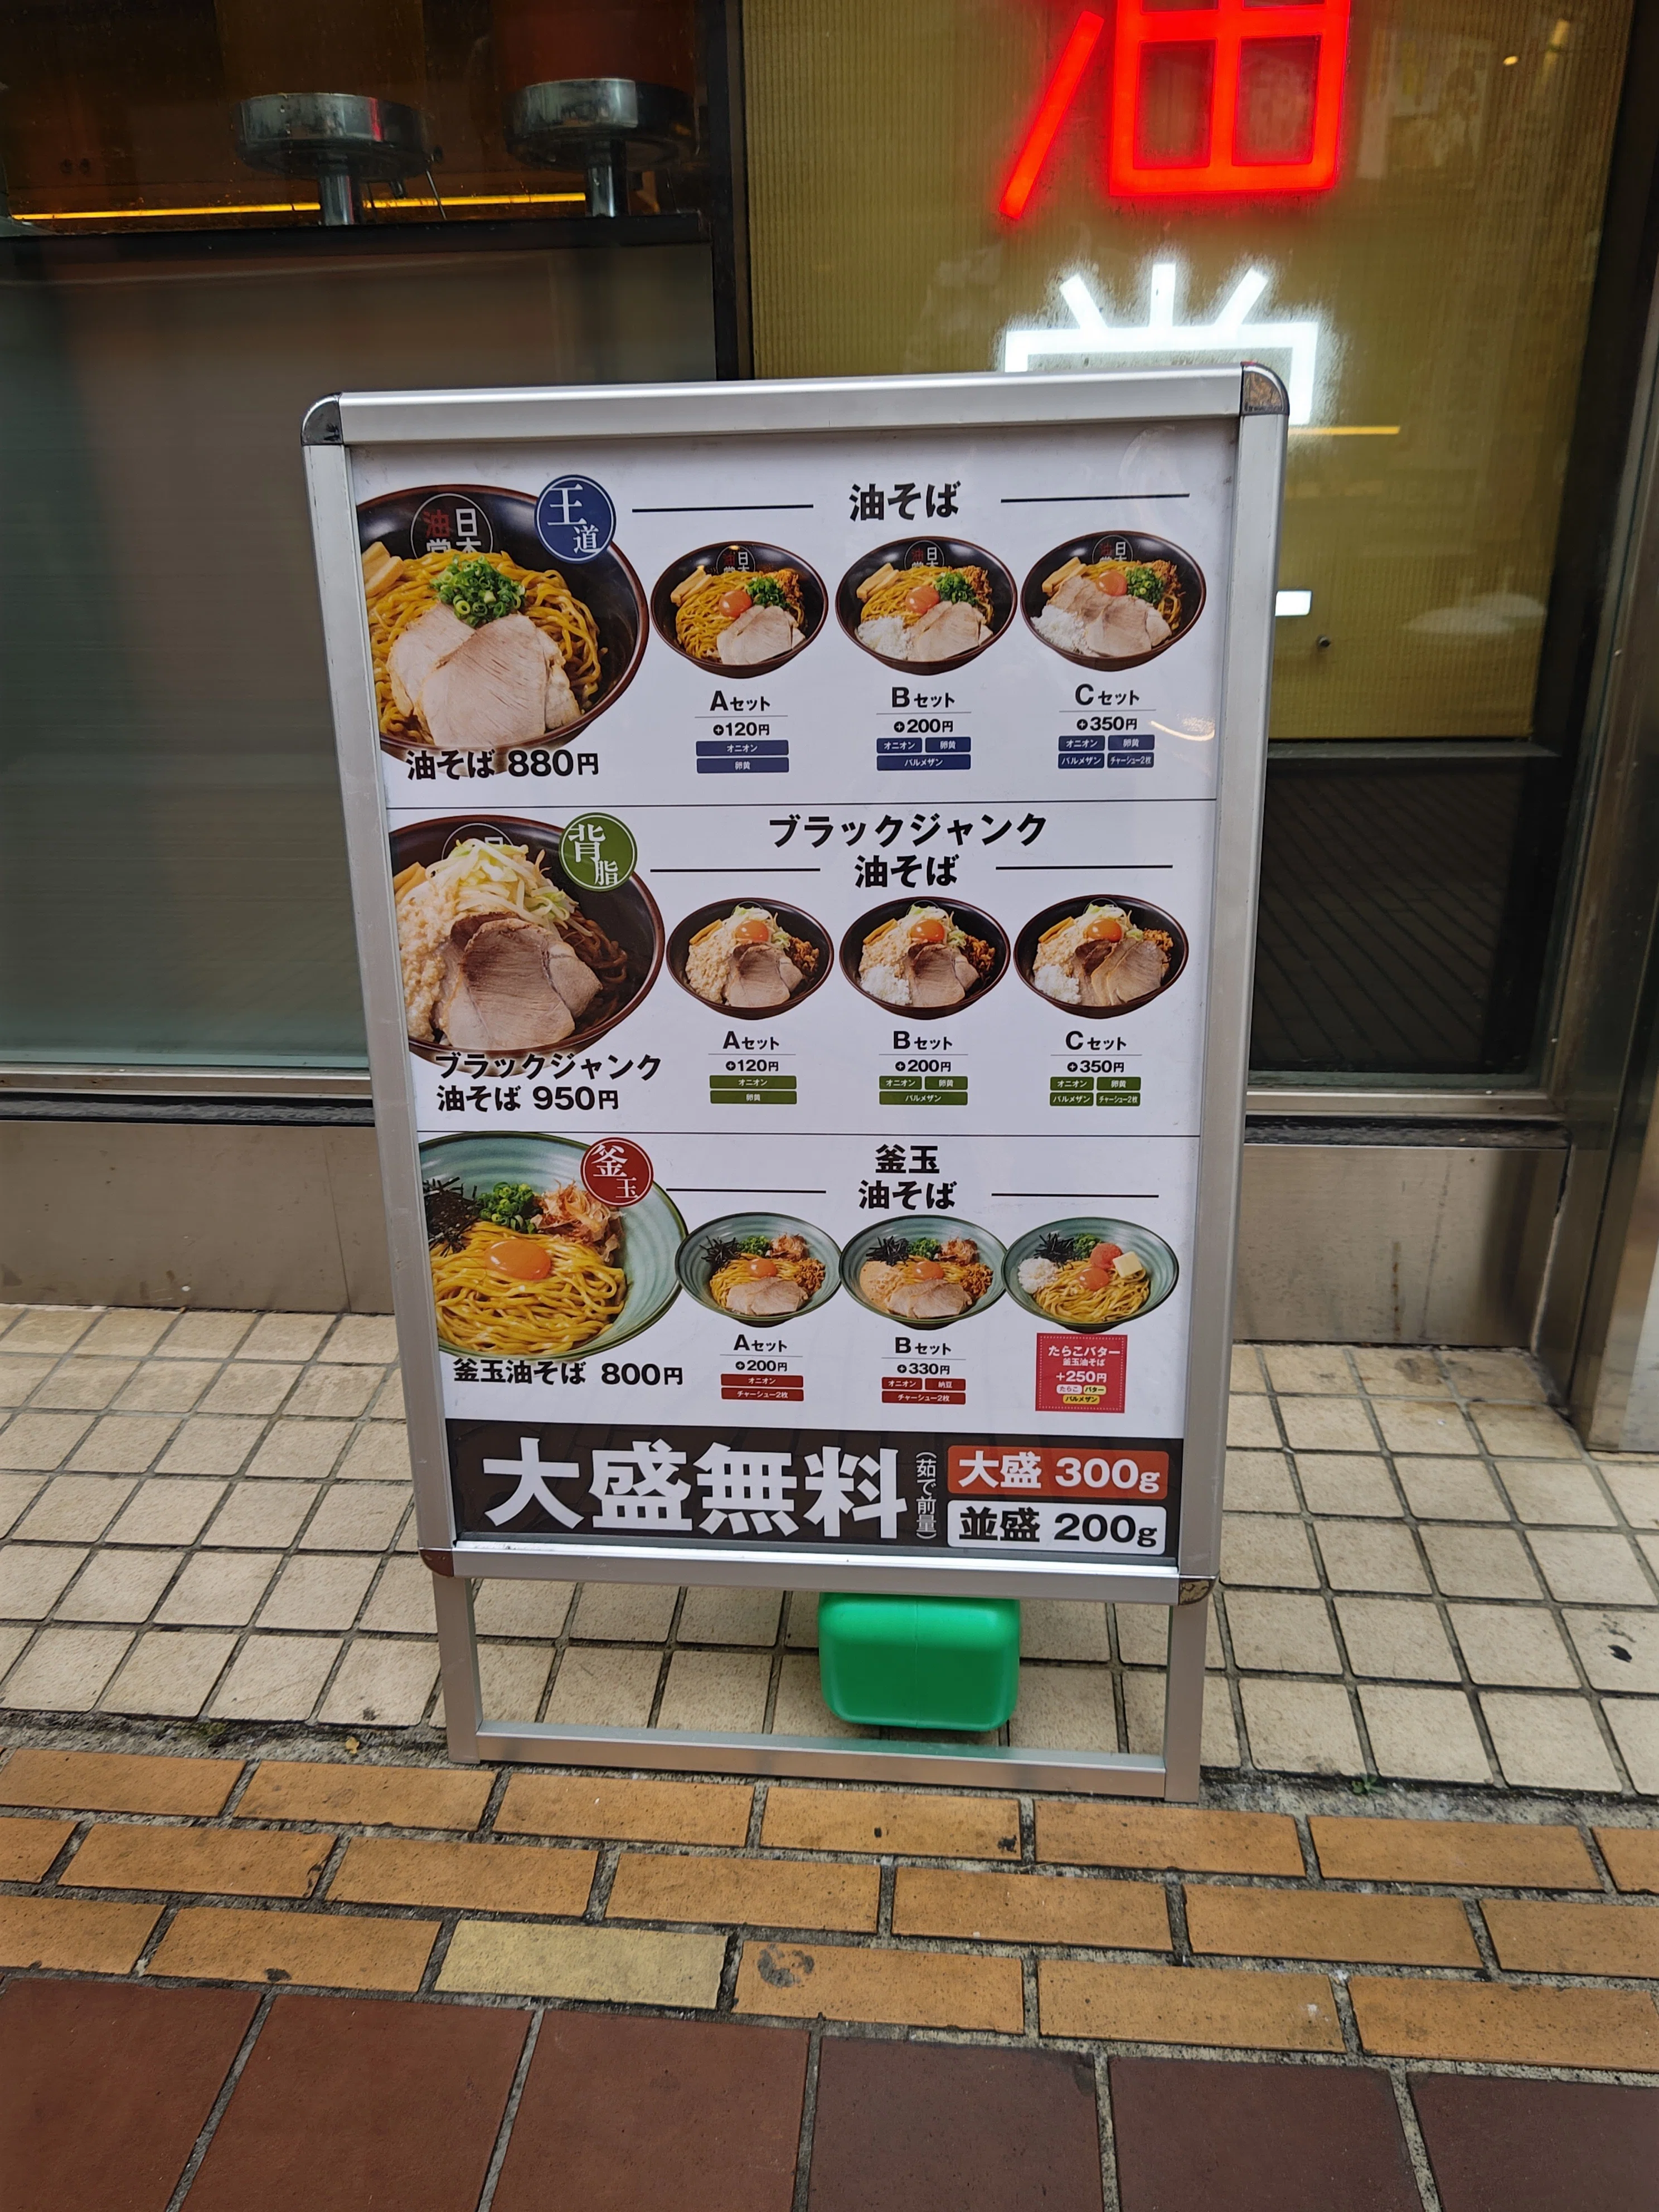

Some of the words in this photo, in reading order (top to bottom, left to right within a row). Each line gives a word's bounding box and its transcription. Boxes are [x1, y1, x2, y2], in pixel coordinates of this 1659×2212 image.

[849, 481, 961, 521] 油そば
[547, 483, 601, 554] 王道
[710, 690, 770, 711] Aセット
[892, 687, 955, 708] Bセット
[1075, 684, 1139, 705] Cセット
[726, 744, 758, 753] オニオン
[884, 741, 915, 750] オニオン
[940, 740, 956, 750] 卵黄
[1066, 739, 1098, 748] オニオン
[1123, 738, 1139, 748] 卵黄
[407, 749, 496, 780] 油そば
[508, 749, 599, 777] 880円
[735, 761, 750, 770] 卵黄
[1110, 756, 1151, 765] チャーシュー2枚
[769, 813, 1046, 848] ブラックジャンク
[568, 823, 619, 886] 背脂
[855, 853, 959, 889] 油そば
[722, 1031, 780, 1050] Aセット
[893, 1031, 953, 1050] Bセット
[1065, 1031, 1127, 1051] Cセット
[435, 1051, 661, 1080] ブラックジャンク
[738, 1078, 768, 1086] オニオン
[938, 1079, 954, 1088] 卵黄
[1057, 1080, 1088, 1088] オニオン
[1111, 1080, 1127, 1088] 卵黄
[436, 1085, 521, 1112] 油そば
[532, 1086, 619, 1111] 950円
[746, 1093, 761, 1102] 卵黄
[1099, 1095, 1138, 1104] チャーシュー2枚
[875, 1144, 940, 1173] 釜玉
[591, 1144, 639, 1200] 釜玉
[858, 1180, 958, 1210] 油そば
[733, 1334, 788, 1352] Aセット
[895, 1337, 952, 1356] Bセット
[1048, 1345, 1120, 1357] たらこバター
[1063, 1358, 1105, 1366] 釜玉油そば
[453, 1357, 586, 1385] 釜玉油そば
[601, 1362, 683, 1386] 800円
[748, 1376, 777, 1385] オニオン
[1056, 1370, 1107, 1382] +250円
[888, 1379, 916, 1388] オニオン
[938, 1380, 953, 1389] 納豆
[736, 1390, 788, 1399] チャーシュー2枚
[897, 1393, 950, 1403] チャーシュー2枚
[958, 1451, 1042, 1489] 大盛
[1055, 1457, 1160, 1494] 300g
[483, 1437, 908, 1539] 大盛無料
[959, 1507, 1040, 1543] 並盛
[1054, 1513, 1158, 1548] 200g
